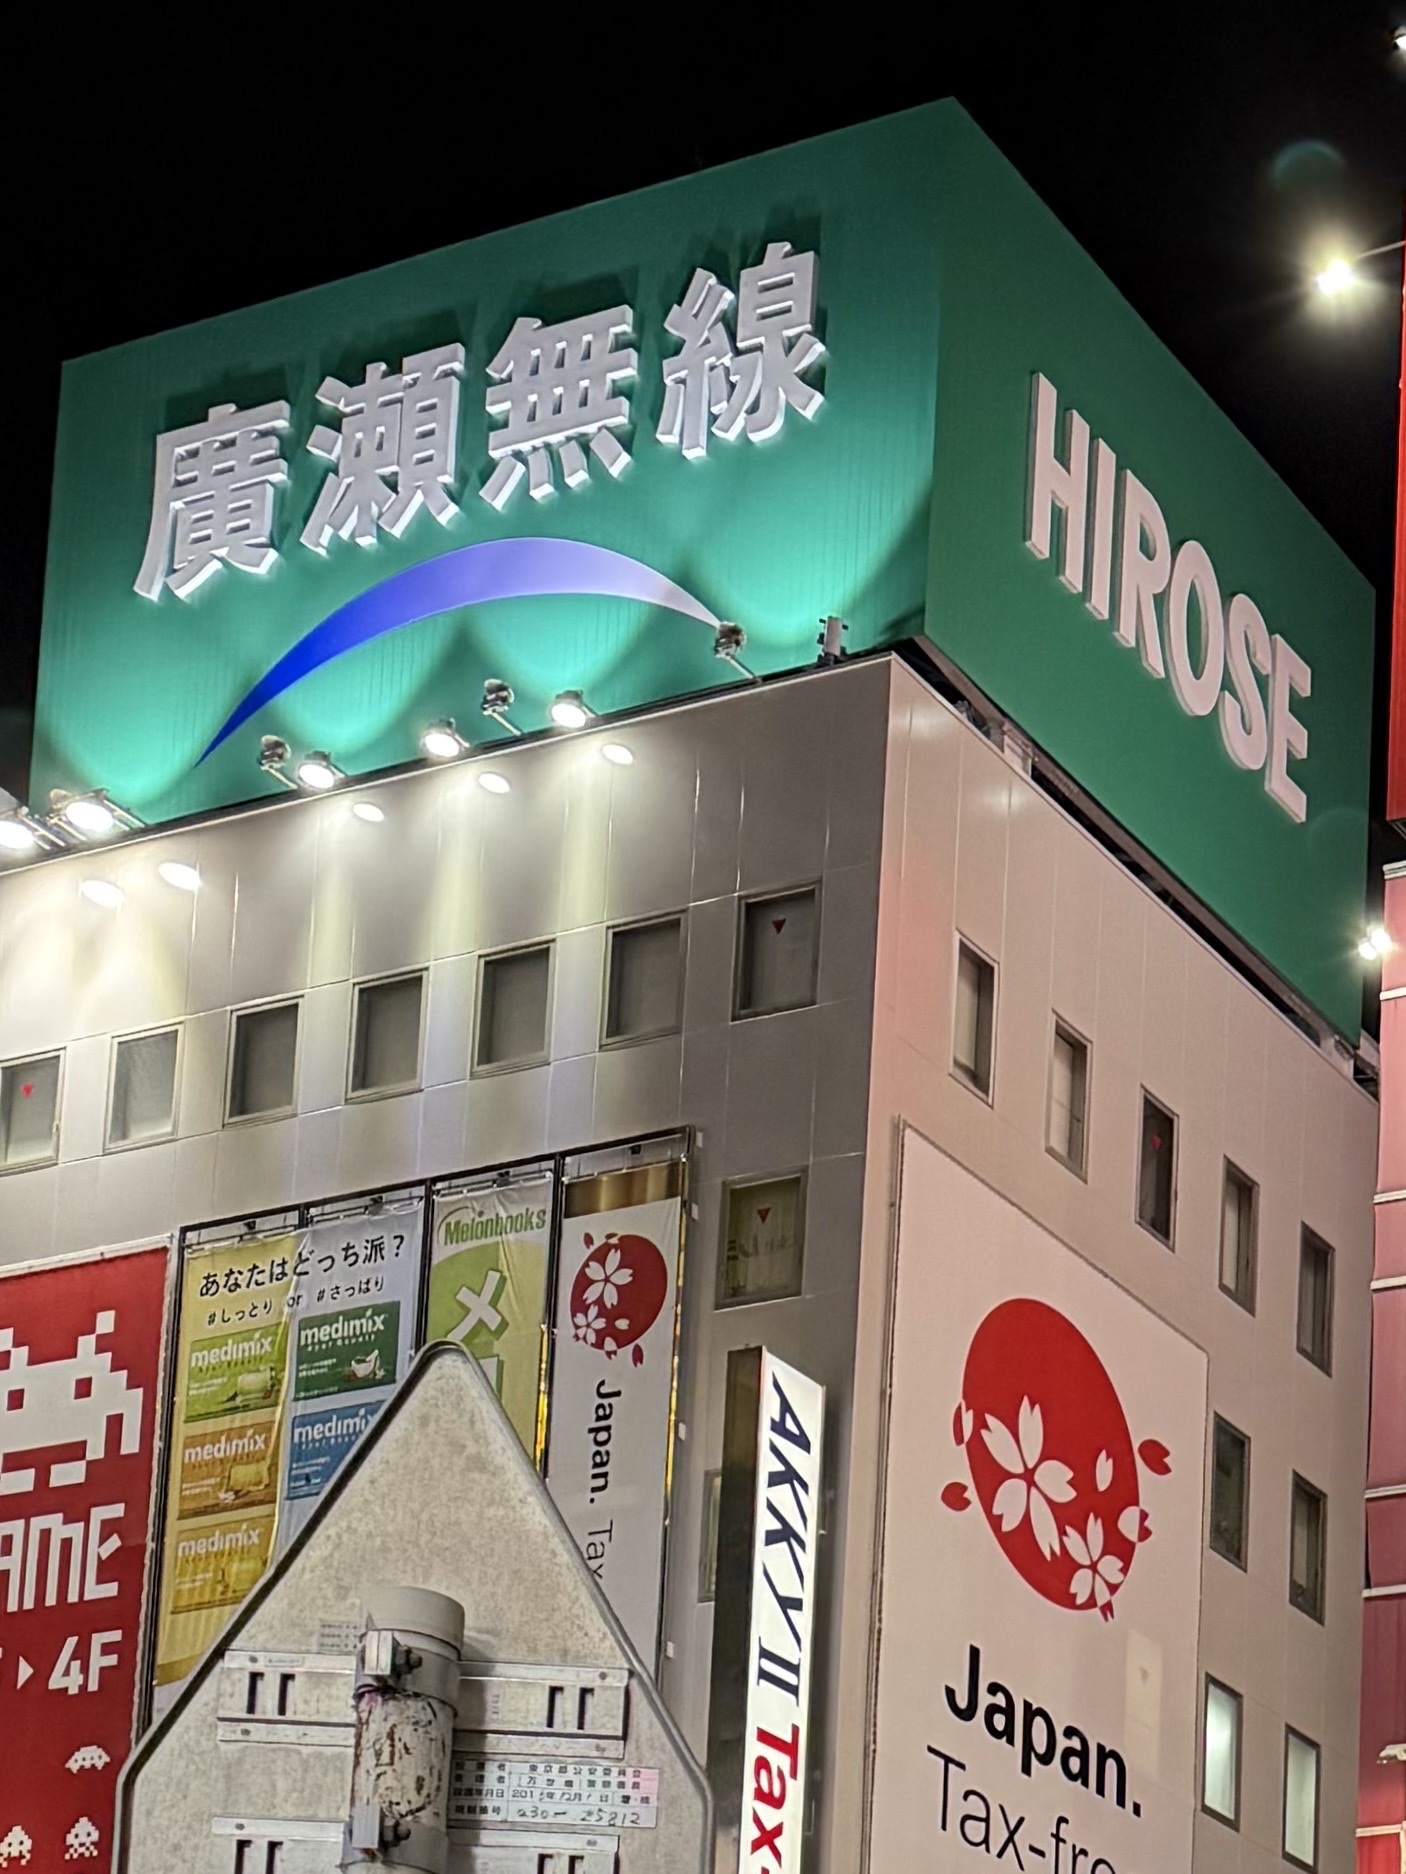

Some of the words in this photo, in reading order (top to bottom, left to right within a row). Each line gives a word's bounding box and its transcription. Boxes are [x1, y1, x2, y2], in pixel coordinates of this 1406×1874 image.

[1025, 371, 1312, 823] HIROSE
[443, 1207, 546, 1247] Melonbooks
[300, 1309, 387, 1346] medimix
[190, 1331, 273, 1368] medimix
[184, 1430, 266, 1463] medimix
[586, 1378, 622, 1504] Japan.
[177, 1524, 260, 1557] medimix
[48, 1629, 123, 1696] 4F
[944, 1644, 1142, 1818] Japan.
